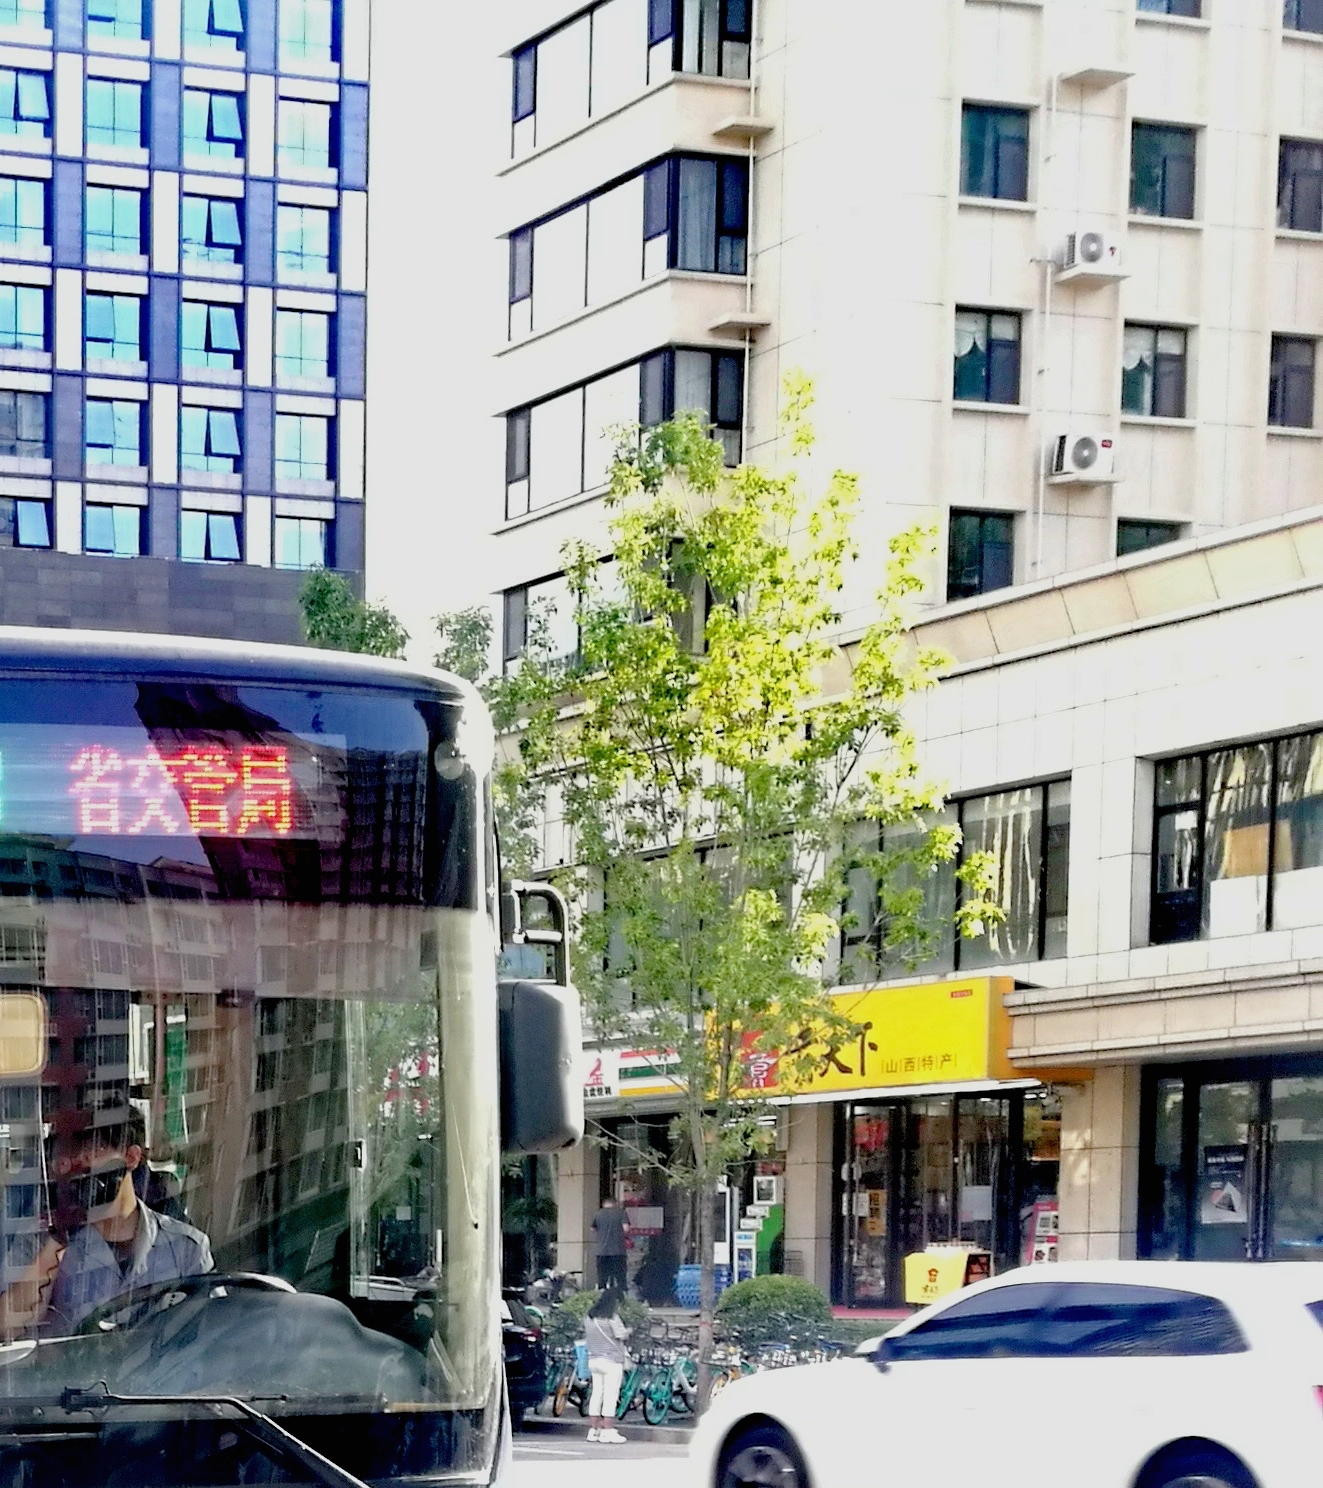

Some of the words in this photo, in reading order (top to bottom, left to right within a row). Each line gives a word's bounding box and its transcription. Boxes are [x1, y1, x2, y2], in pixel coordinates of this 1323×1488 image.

[68, 744, 291, 836] 省交管局
[884, 1054, 955, 1075] 山西特产
